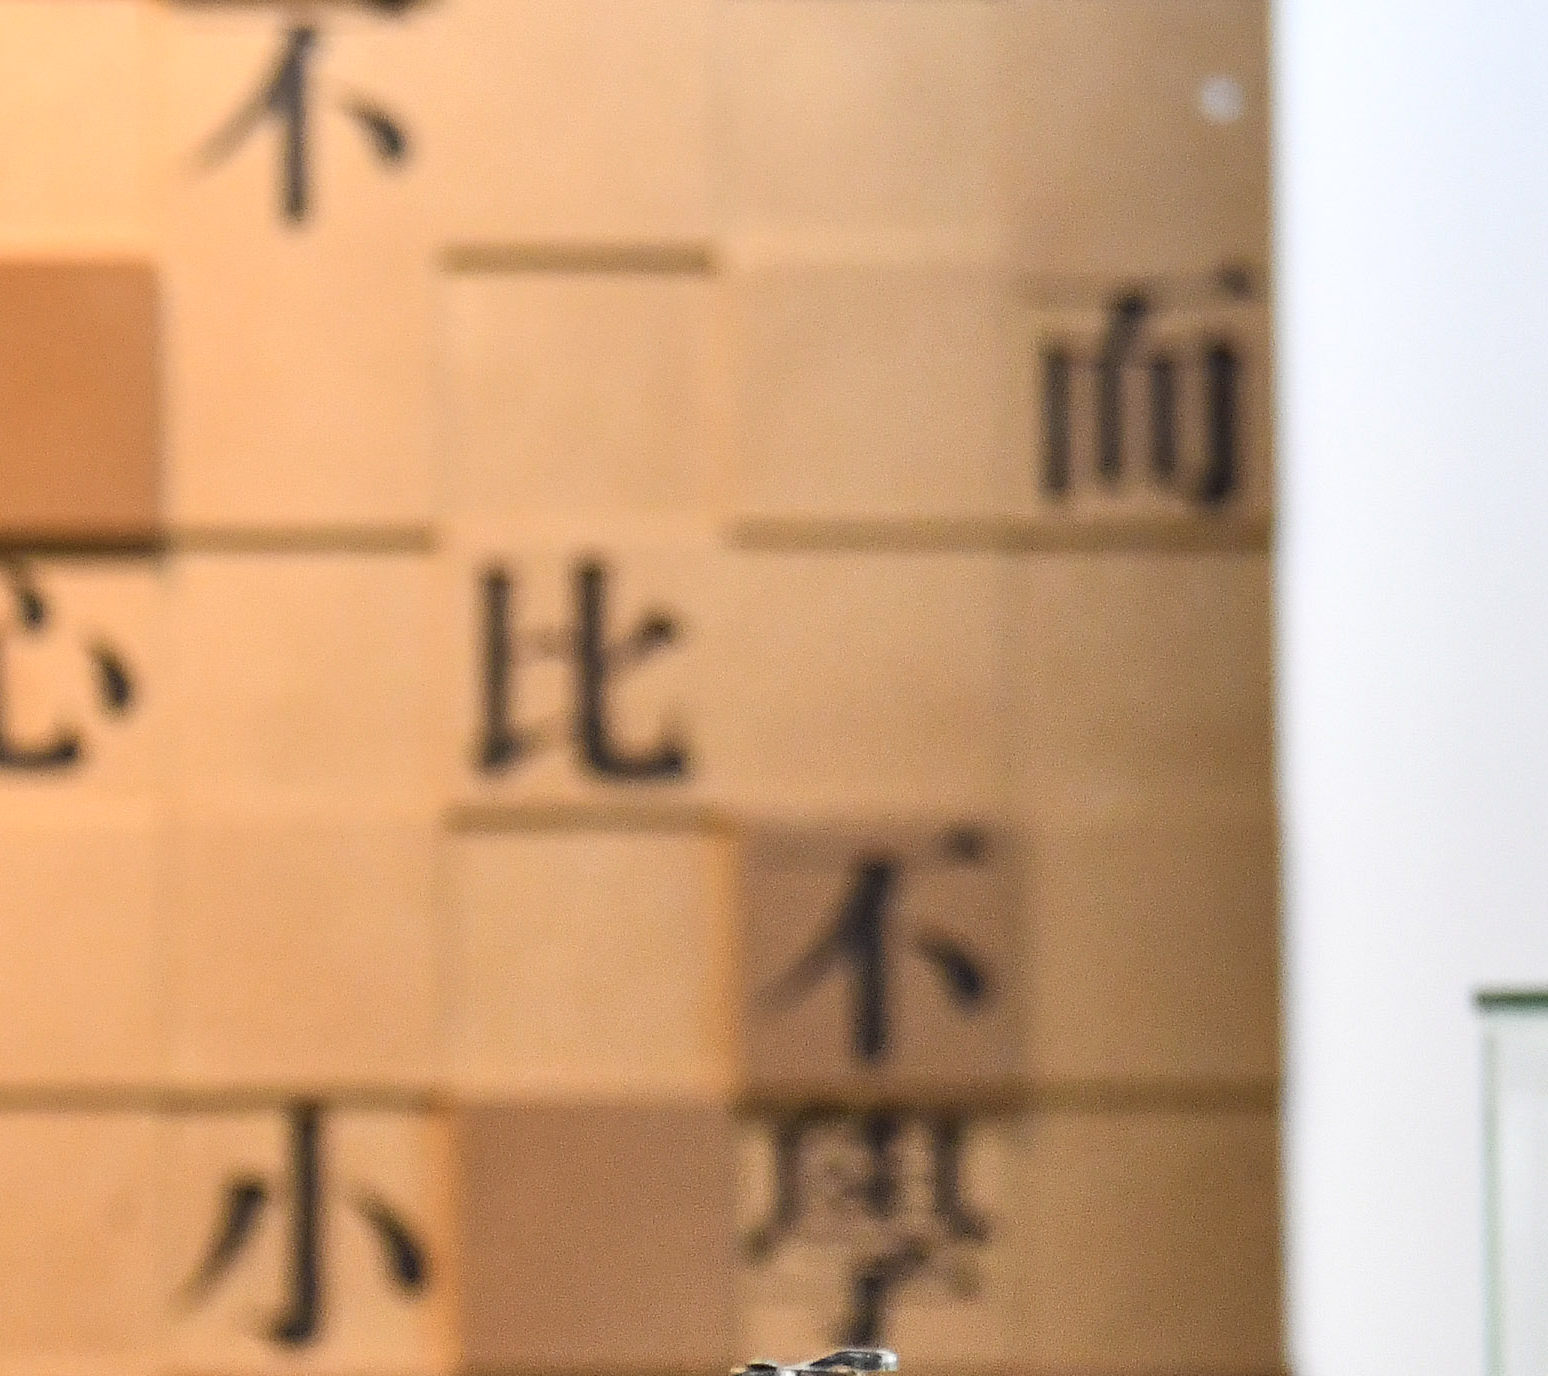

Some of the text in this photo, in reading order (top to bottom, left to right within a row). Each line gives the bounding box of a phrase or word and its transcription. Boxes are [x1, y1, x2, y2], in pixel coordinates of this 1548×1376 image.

[1021, 266, 1263, 507] 而
[471, 554, 693, 785] 比
[751, 827, 996, 1066] 不
[185, 1102, 428, 1349] 小
